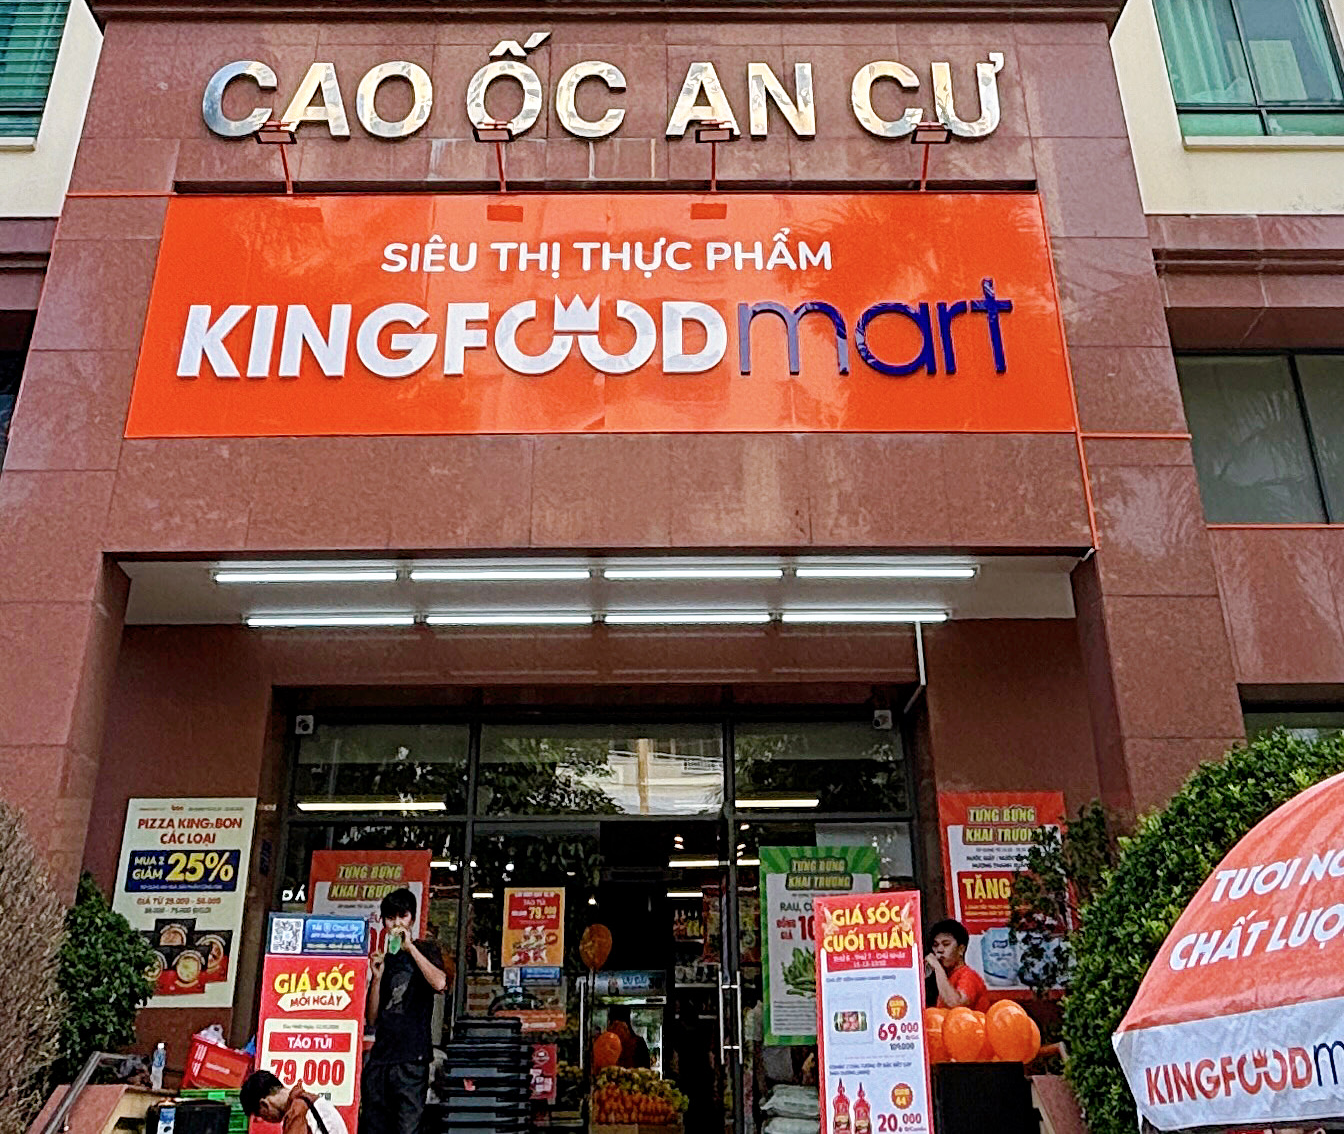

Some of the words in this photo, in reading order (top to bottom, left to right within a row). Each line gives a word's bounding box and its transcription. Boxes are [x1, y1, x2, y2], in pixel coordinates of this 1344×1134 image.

[202, 59, 435, 138] CAO
[466, 31, 627, 138] ỐC
[665, 60, 817, 138] AN
[850, 52, 1005, 138] CƯ
[381, 235, 478, 273] SIÊU
[490, 240, 563, 280] THỊ
[575, 236, 693, 277] THỰC
[706, 227, 833, 272] PHẨM
[137, 818, 176, 829] PIZZA
[965, 827, 993, 842] KHAI
[997, 826, 1044, 843] TRƯƠN
[160, 831, 185, 845] CÁC
[187, 832, 217, 847] LOẠI
[132, 866, 164, 880] GIẢM
[134, 856, 157, 866] MUA
[158, 856, 165, 866] 2
[164, 851, 235, 882] 25%
[330, 885, 359, 899] KHAI
[362, 884, 400, 899] TRƯƠ
[962, 873, 1012, 903] TẶNG
[1210, 857, 1302, 903] TƯƠI
[832, 903, 864, 926] GIÁ
[866, 900, 901, 925] SỐC
[823, 926, 865, 953] CUỐI
[867, 925, 915, 950] TUẦN
[1168, 910, 1269, 971] CHẤT
[274, 967, 312, 995] GIÁ
[316, 963, 355, 992] SỐC
[287, 1033, 312, 1049] TÁO
[270, 1058, 346, 1087] 79000
